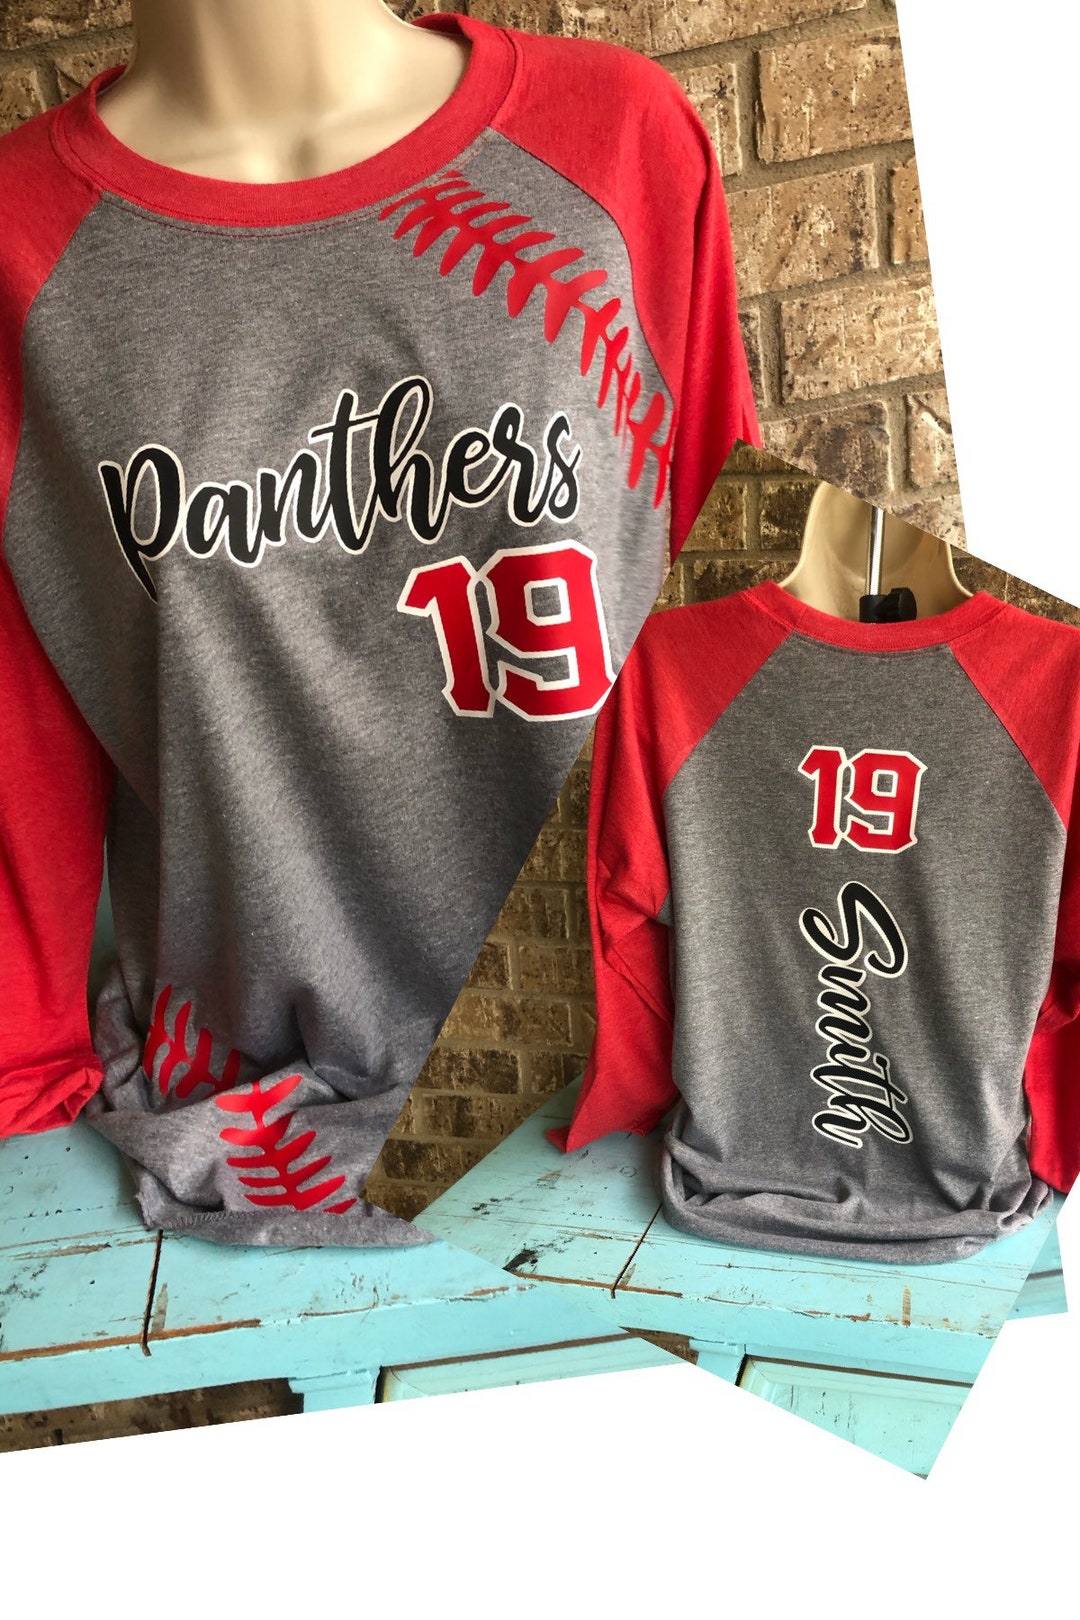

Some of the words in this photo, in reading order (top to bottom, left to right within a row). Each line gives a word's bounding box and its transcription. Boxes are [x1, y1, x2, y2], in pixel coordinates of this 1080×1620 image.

[397, 539, 617, 722] 19
[798, 745, 927, 854] 19
[799, 881, 913, 1148] Smith
